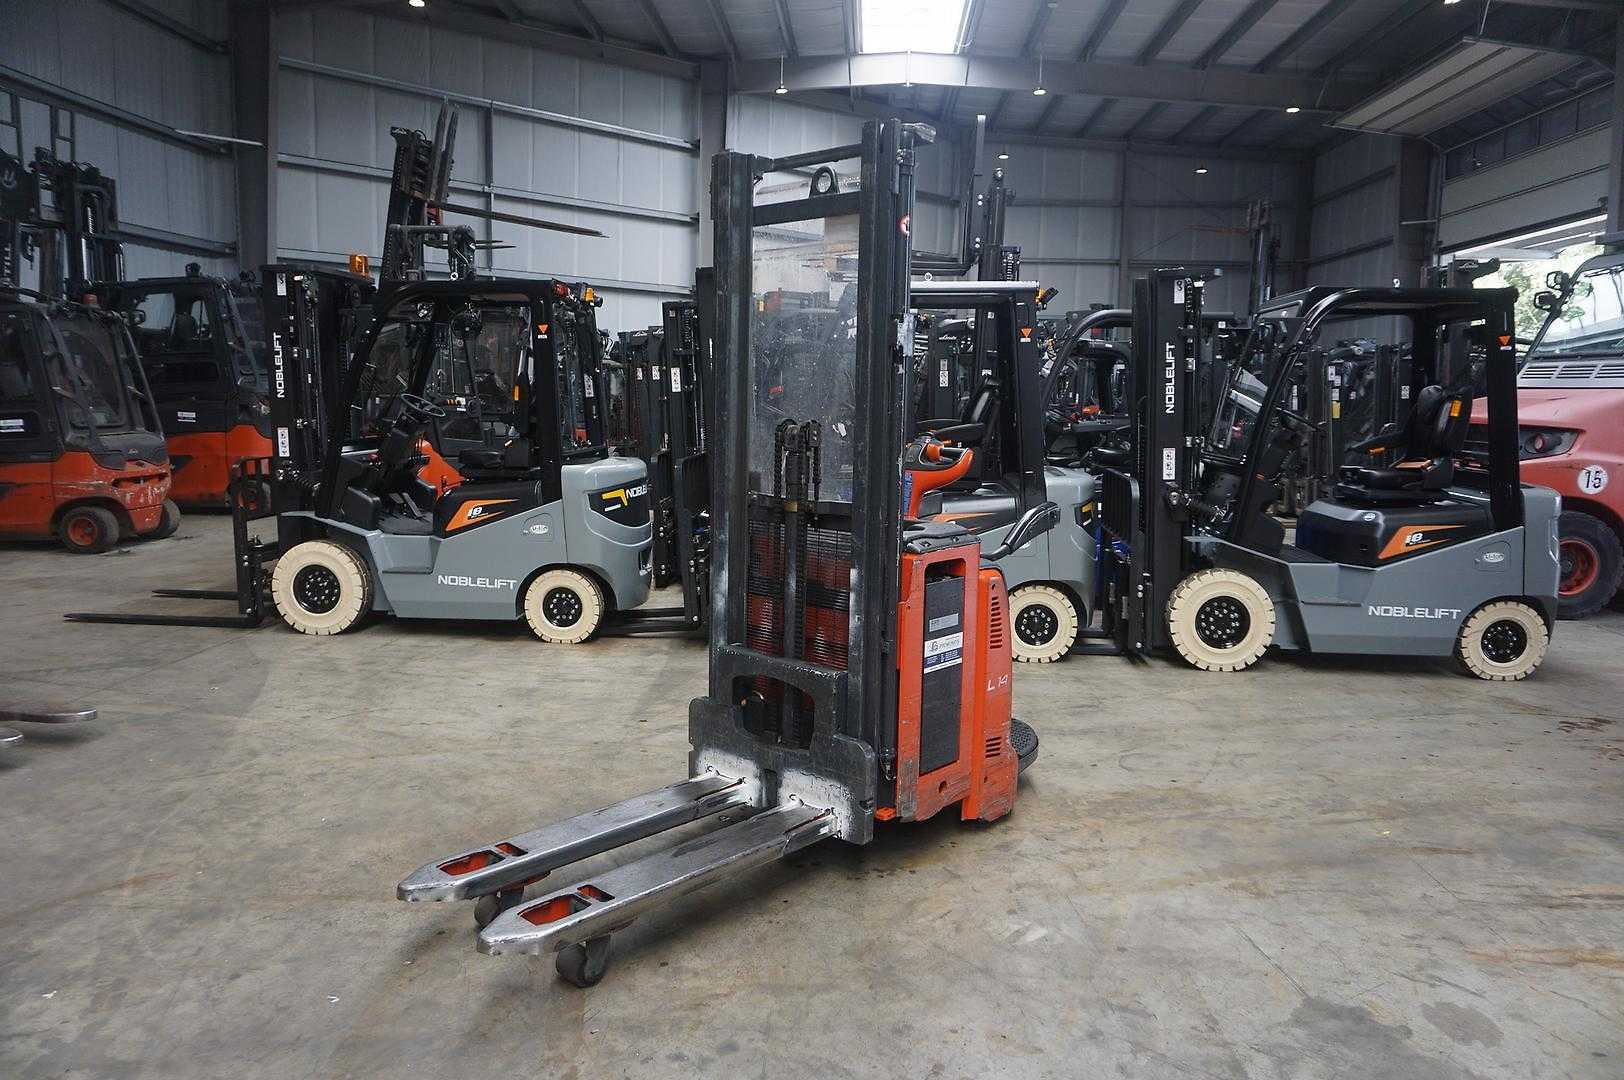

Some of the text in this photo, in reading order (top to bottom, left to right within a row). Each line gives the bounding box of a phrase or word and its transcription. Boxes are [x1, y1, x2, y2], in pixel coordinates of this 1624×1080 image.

[273, 332, 285, 398] NOBLELIFT
[1165, 342, 1176, 414] NOBLELIFT
[1585, 470, 1602, 489] 15
[437, 574, 517, 590] NOBLELIFT
[1368, 605, 1461, 620] NOBLELIFT
